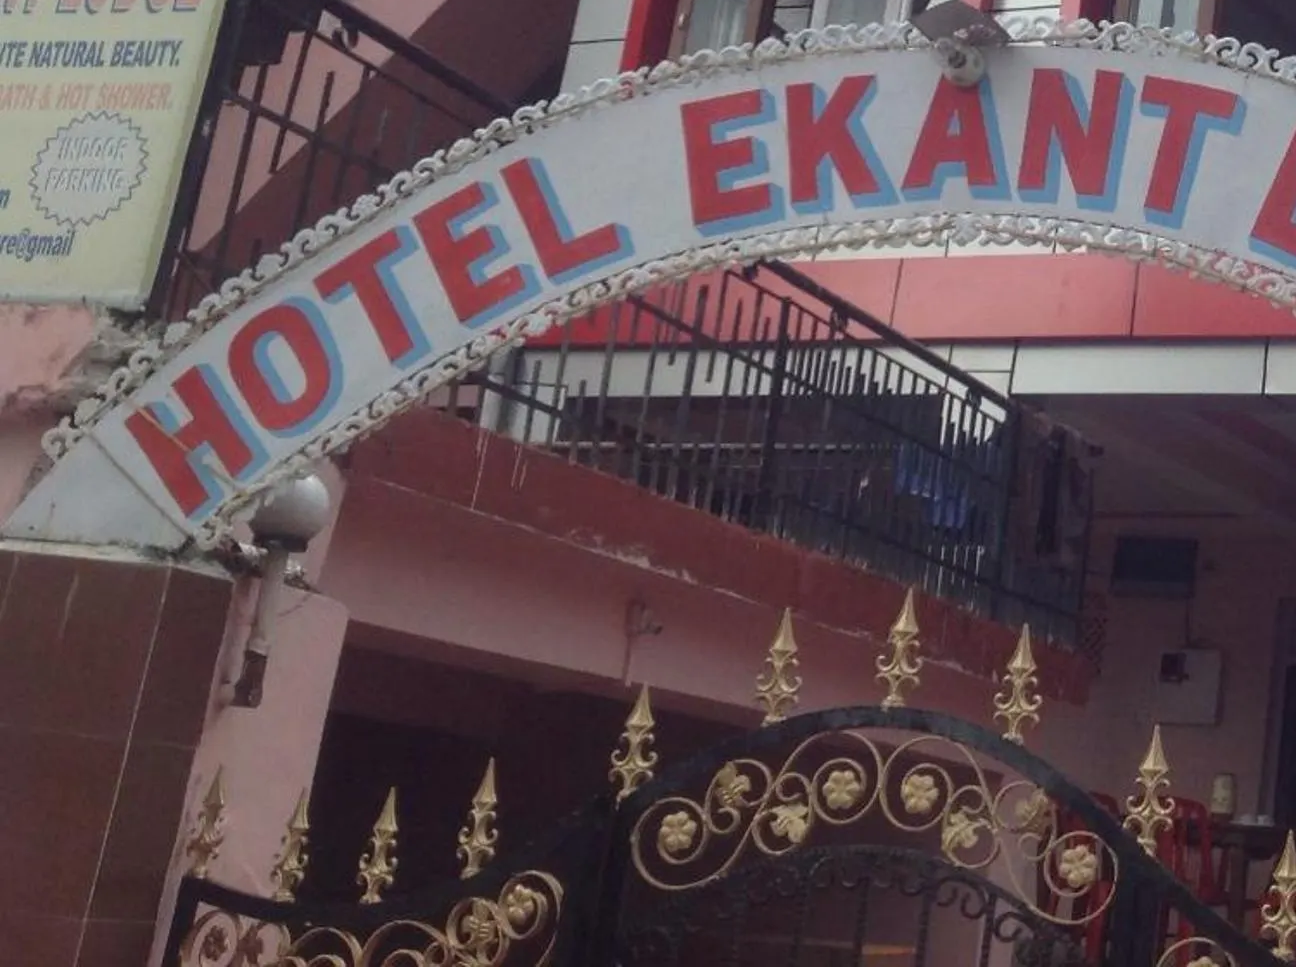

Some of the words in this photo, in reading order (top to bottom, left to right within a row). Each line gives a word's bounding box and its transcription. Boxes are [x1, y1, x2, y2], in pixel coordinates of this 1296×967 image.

[28, 40, 105, 69] NATURAL
[110, 39, 183, 68] BEAUTY.
[55, 83, 95, 111] HOT
[97, 82, 174, 110] SHOWER.
[57, 136, 129, 161] INDOOR
[45, 167, 126, 193] PARKING
[120, 156, 632, 524] HOTEL
[679, 67, 1246, 230] EKANT
